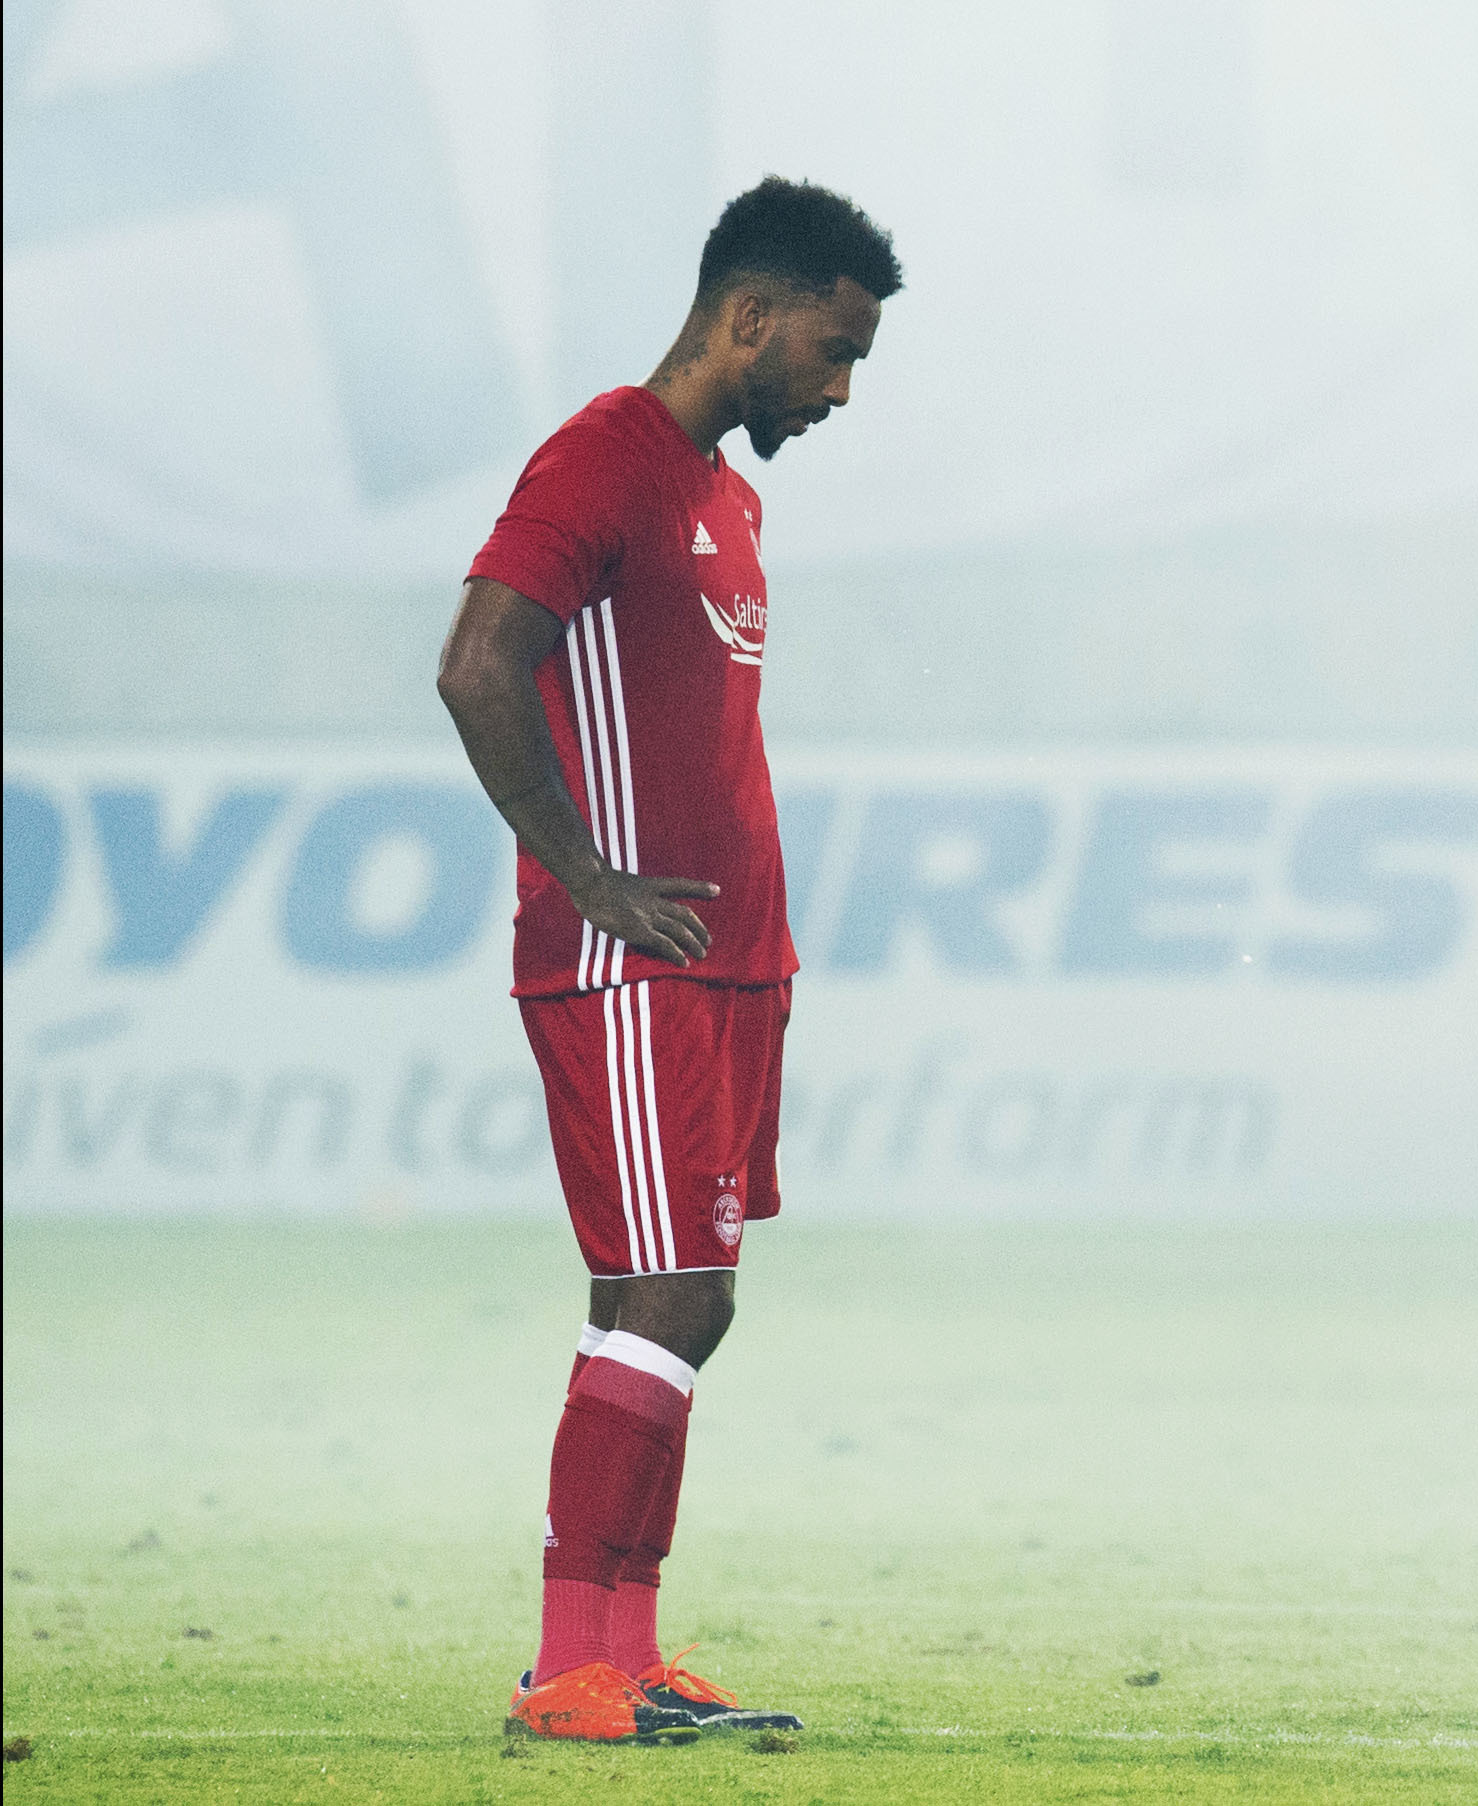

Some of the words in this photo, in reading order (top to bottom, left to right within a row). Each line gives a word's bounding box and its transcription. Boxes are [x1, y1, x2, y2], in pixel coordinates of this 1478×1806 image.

[4, 775, 517, 980] YO
[388, 1050, 549, 1173] to
[785, 1022, 1280, 1178] rform
